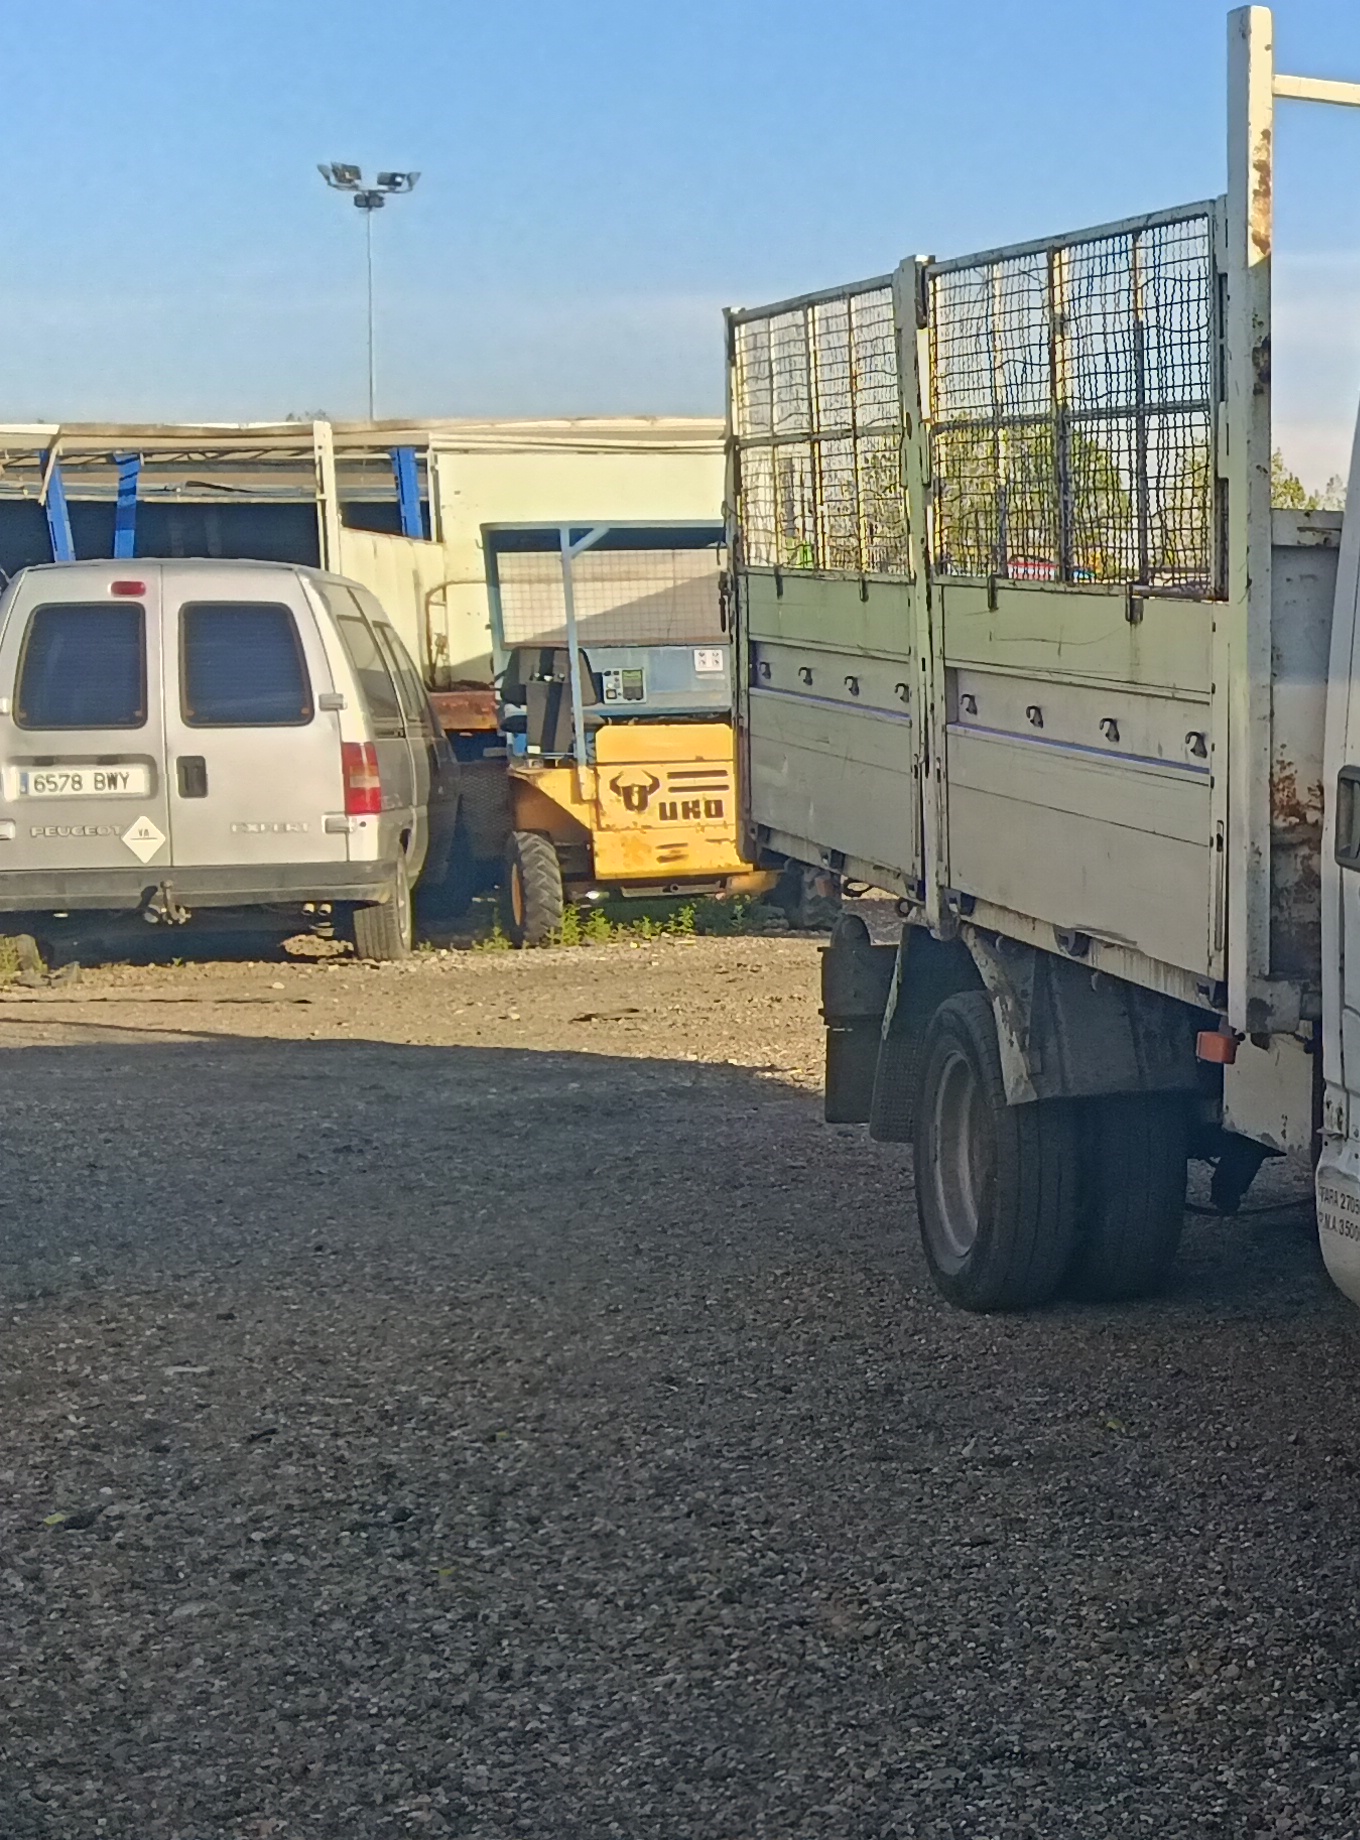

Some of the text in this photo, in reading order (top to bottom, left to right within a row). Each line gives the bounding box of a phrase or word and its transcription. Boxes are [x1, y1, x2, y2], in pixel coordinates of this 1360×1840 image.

[34, 771, 130, 793] 6578 BWY
[30, 824, 123, 839] PEUGEOT
